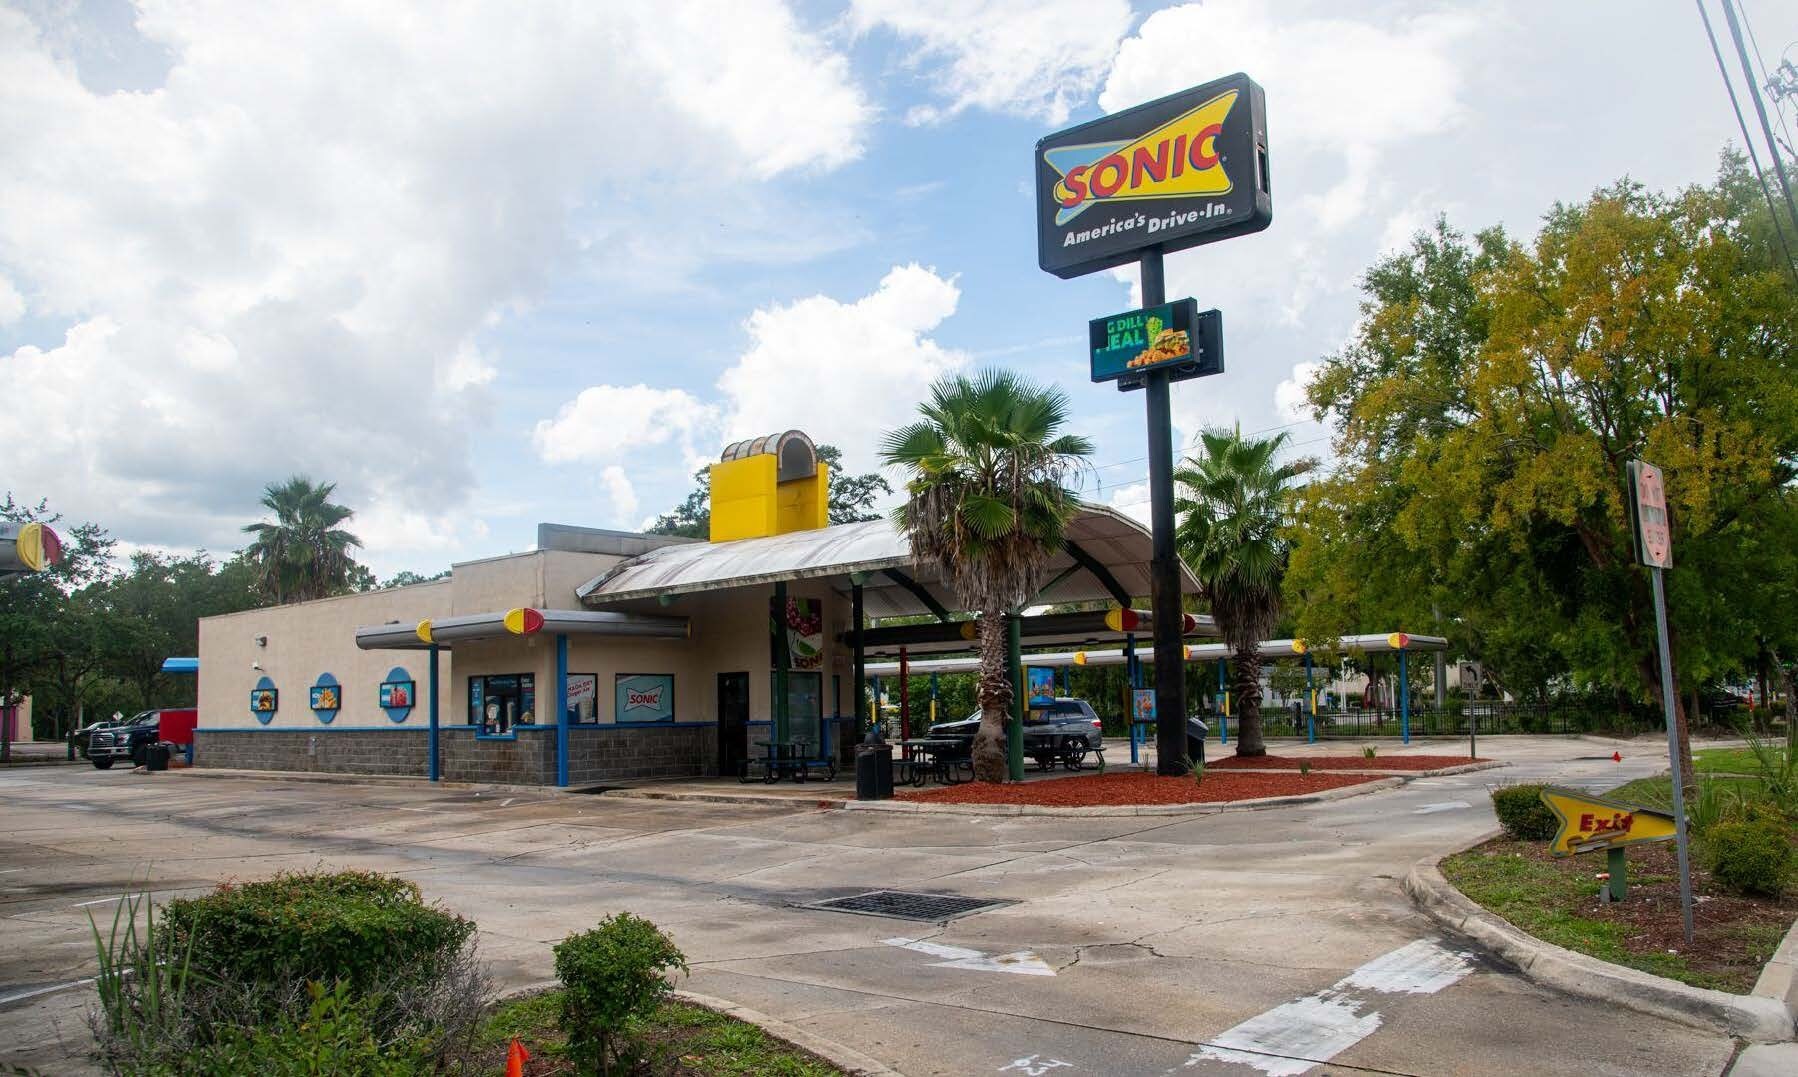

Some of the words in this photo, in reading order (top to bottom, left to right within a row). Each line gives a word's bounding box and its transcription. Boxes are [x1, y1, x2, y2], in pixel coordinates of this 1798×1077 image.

[1061, 123, 1223, 208] SONIC
[1063, 211, 1146, 247] America's
[1117, 315, 1144, 331] DILL
[1106, 329, 1144, 351] EAL
[629, 693, 658, 704] SONIC
[1579, 812, 1634, 833] Exit
